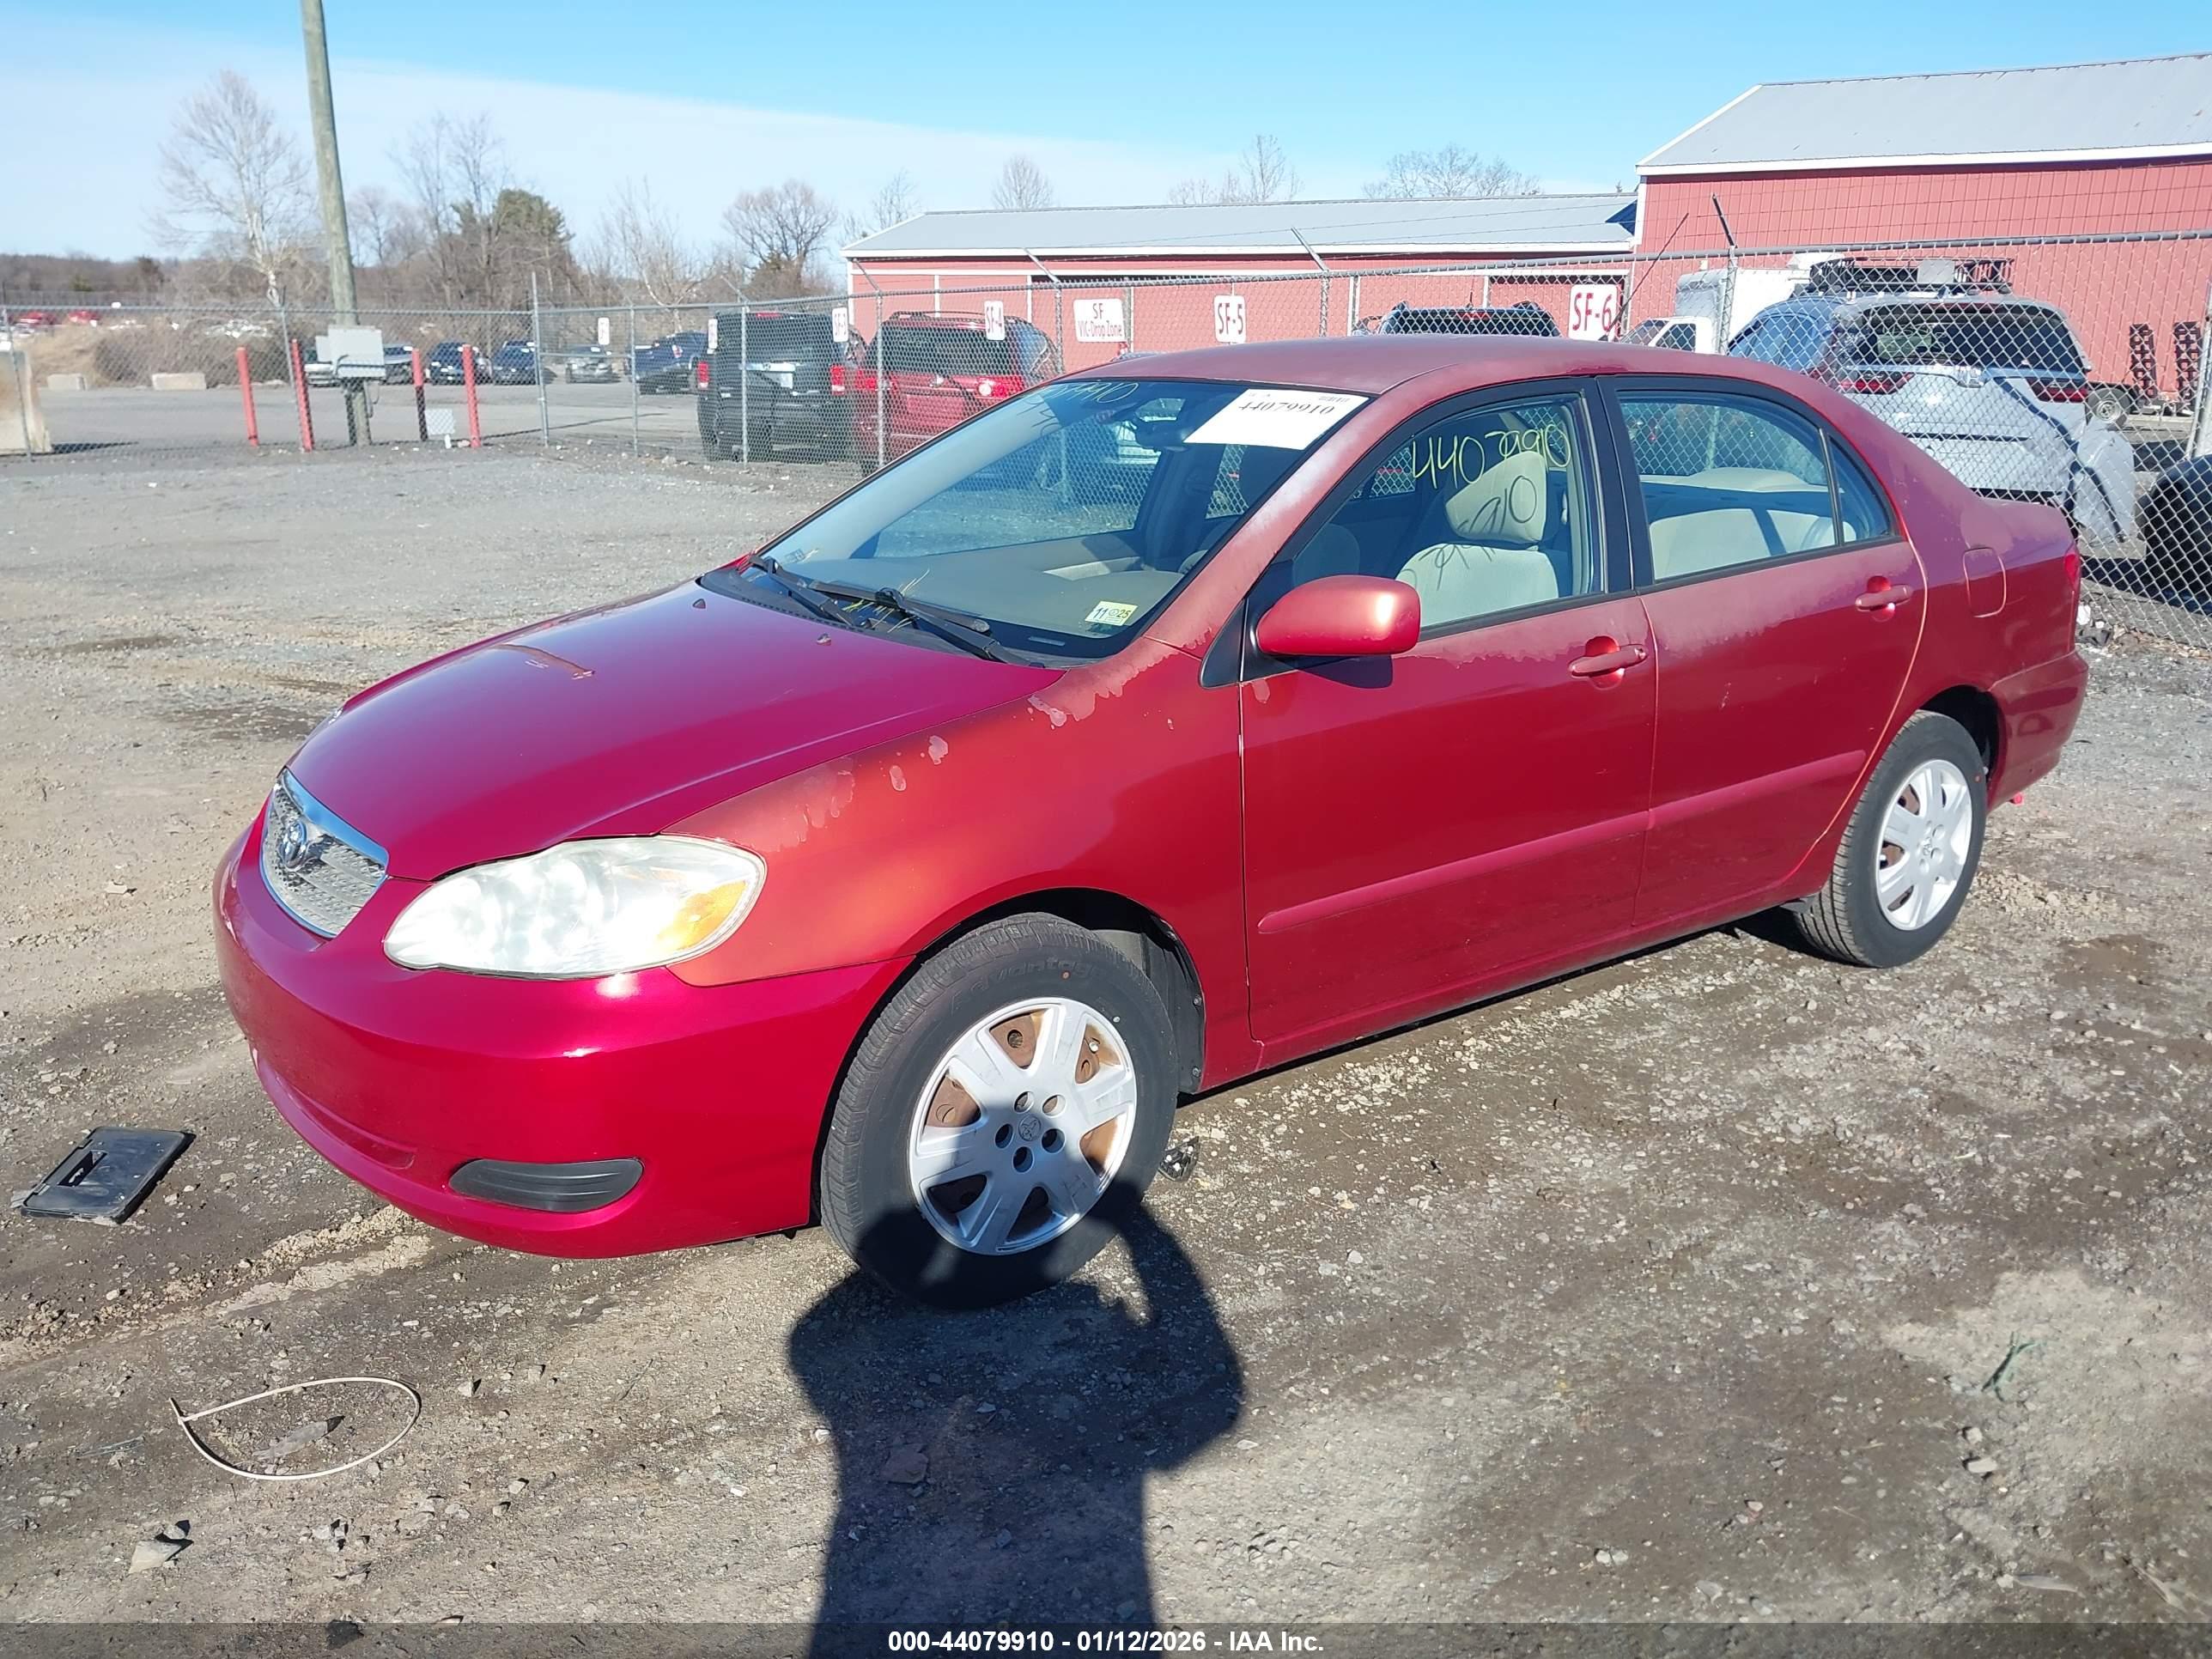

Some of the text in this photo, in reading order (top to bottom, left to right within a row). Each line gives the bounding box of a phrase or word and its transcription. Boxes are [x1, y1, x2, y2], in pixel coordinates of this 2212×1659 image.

[986, 306, 1003, 333] SF-4
[1092, 302, 1103, 320] SF
[1218, 302, 1243, 334] SF-5
[1572, 293, 1612, 331] SF-6
[1238, 401, 1335, 415] 44079910
[1093, 607, 1132, 619] 11 25
